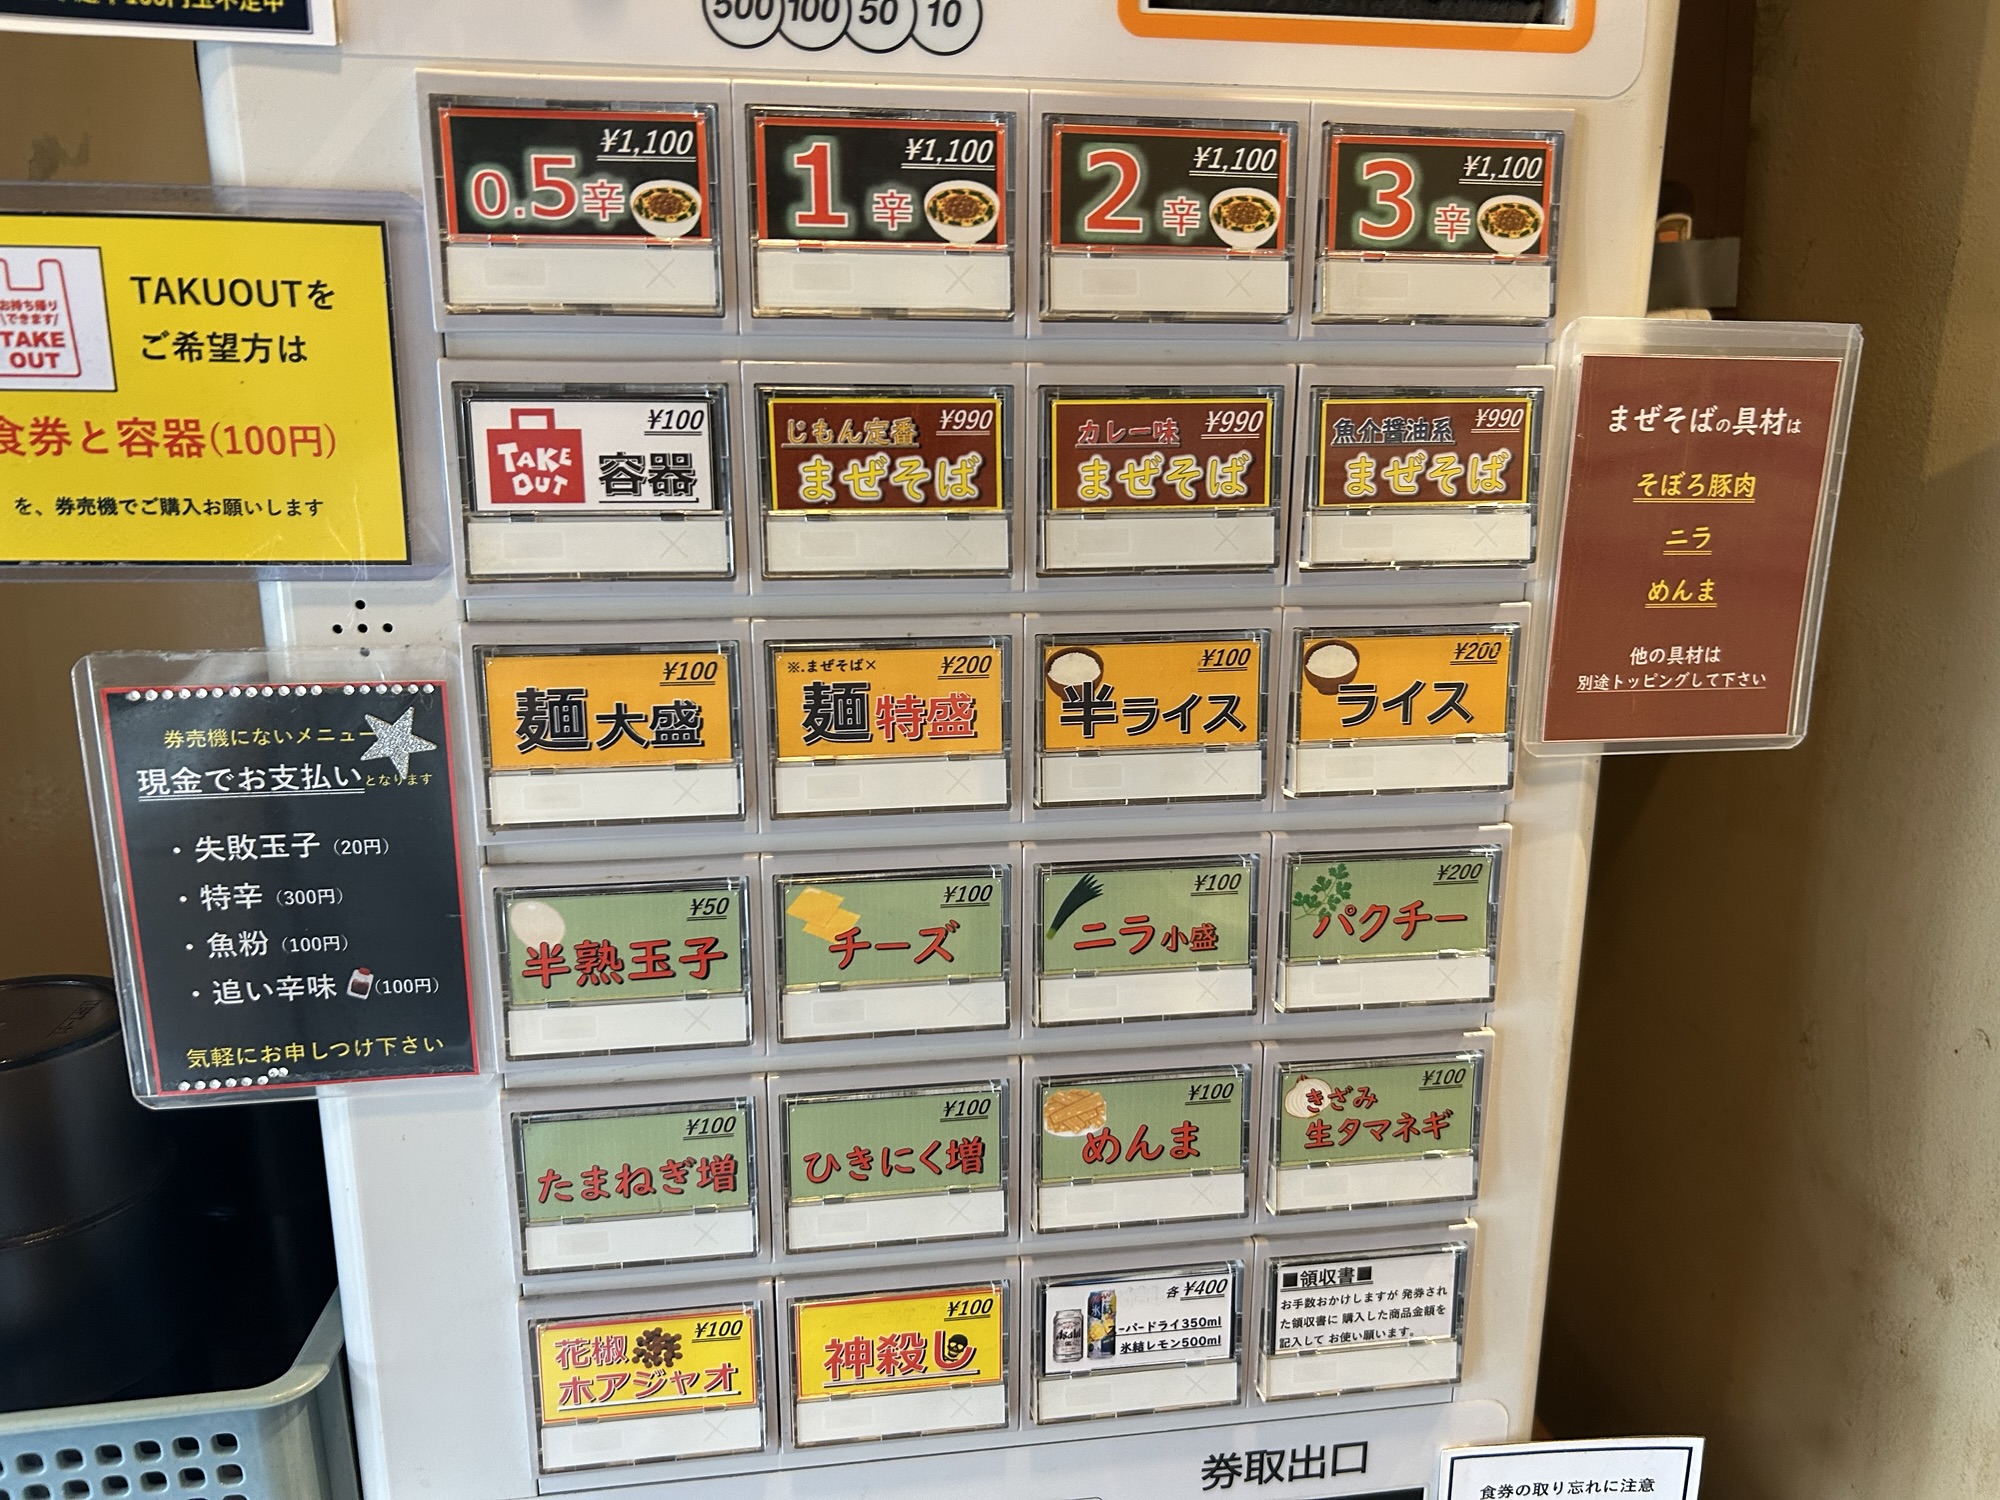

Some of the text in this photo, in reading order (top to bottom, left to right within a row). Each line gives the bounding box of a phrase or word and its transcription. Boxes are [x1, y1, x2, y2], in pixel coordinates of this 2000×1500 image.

[713, 0, 773, 20] 500
[789, 0, 838, 22] 100
[859, 0, 898, 25] 50
[927, 0, 962, 27] 10
[601, 128, 694, 158] ¥1,100
[905, 138, 994, 165] ¥1,100
[1194, 147, 1277, 174] ¥1,100
[1464, 156, 1543, 182] ¥1,100
[130, 275, 335, 310] TAKUOUTを
[0, 331, 65, 347] TAKE
[141, 331, 307, 364] ご希望方は
[9, 352, 60, 368] OUT
[647, 409, 704, 431] ¥100
[786, 418, 919, 446] じもん定番
[939, 409, 993, 431] ¥990
[1077, 418, 1181, 445] カレー味
[1205, 410, 1264, 433] ¥990
[1332, 417, 1455, 444] 魚介醤油系
[1475, 409, 1524, 428] ¥990
[1608, 404, 1801, 436] まぜそばの具材は
[497, 441, 573, 474] TAKE
[512, 474, 568, 497] OUT
[598, 451, 699, 499] 容器
[799, 454, 982, 503] まぜそば
[1077, 451, 1253, 499] まぜそば
[1344, 450, 1513, 497] まぜそば
[1637, 472, 1756, 498] そぼろ豚肉
[14, 496, 324, 518] を、券売機でご購入お願いします
[1666, 526, 1711, 550] ニラ
[1648, 579, 1716, 602] めんま
[1201, 648, 1251, 667] ¥100
[1453, 641, 1502, 661] ¥200
[1629, 646, 1721, 665] 他の具材は
[663, 661, 717, 682] ¥100
[941, 655, 992, 676] ¥200
[1577, 672, 1767, 690] 別途トッピングして下さい
[1060, 681, 1246, 739] 半ライス
[1337, 680, 1474, 727] ライス
[516, 687, 703, 753] 麺大盛
[164, 728, 378, 750] 券売機にないメニュー
[194, 832, 390, 864] 失敗玉子 （20円）
[1194, 873, 1242, 892] ¥100
[1437, 863, 1484, 882] ¥200
[200, 883, 344, 913] 特辛 （300円）
[689, 897, 729, 917] ¥50
[943, 884, 993, 904] ¥100
[1073, 914, 1219, 955] ニラ小盛
[1312, 900, 1468, 944] パクチー
[206, 930, 349, 960] 魚粉 （100円）
[828, 919, 960, 970] チーズ
[522, 937, 728, 988] 半熟玉子
[213, 974, 337, 1006] 追い辛味
[186, 1037, 444, 1069] 気軽にお申しつけ下さい
[1421, 1068, 1467, 1087] ¥100
[1188, 1082, 1234, 1101] ¥100
[1305, 1085, 1378, 1113] きざみ
[942, 1099, 991, 1118] ¥100
[685, 1116, 737, 1136] ¥100
[1304, 1108, 1454, 1149] 生タマネギ
[1081, 1119, 1201, 1165] めんま
[803, 1135, 985, 1184] ひきにく増
[537, 1153, 738, 1204] たまねぎ増
[1167, 1279, 1228, 1298] 各 ¥400
[947, 1298, 993, 1318] ¥100
[695, 1320, 743, 1338] ¥100
[554, 1334, 628, 1370] 花椒
[824, 1329, 977, 1382] 神殺し
[1121, 1335, 1222, 1353] 氷結レモン500ml
[558, 1363, 738, 1405] ホアジャオ
[1201, 1441, 1368, 1491] 券取出口
